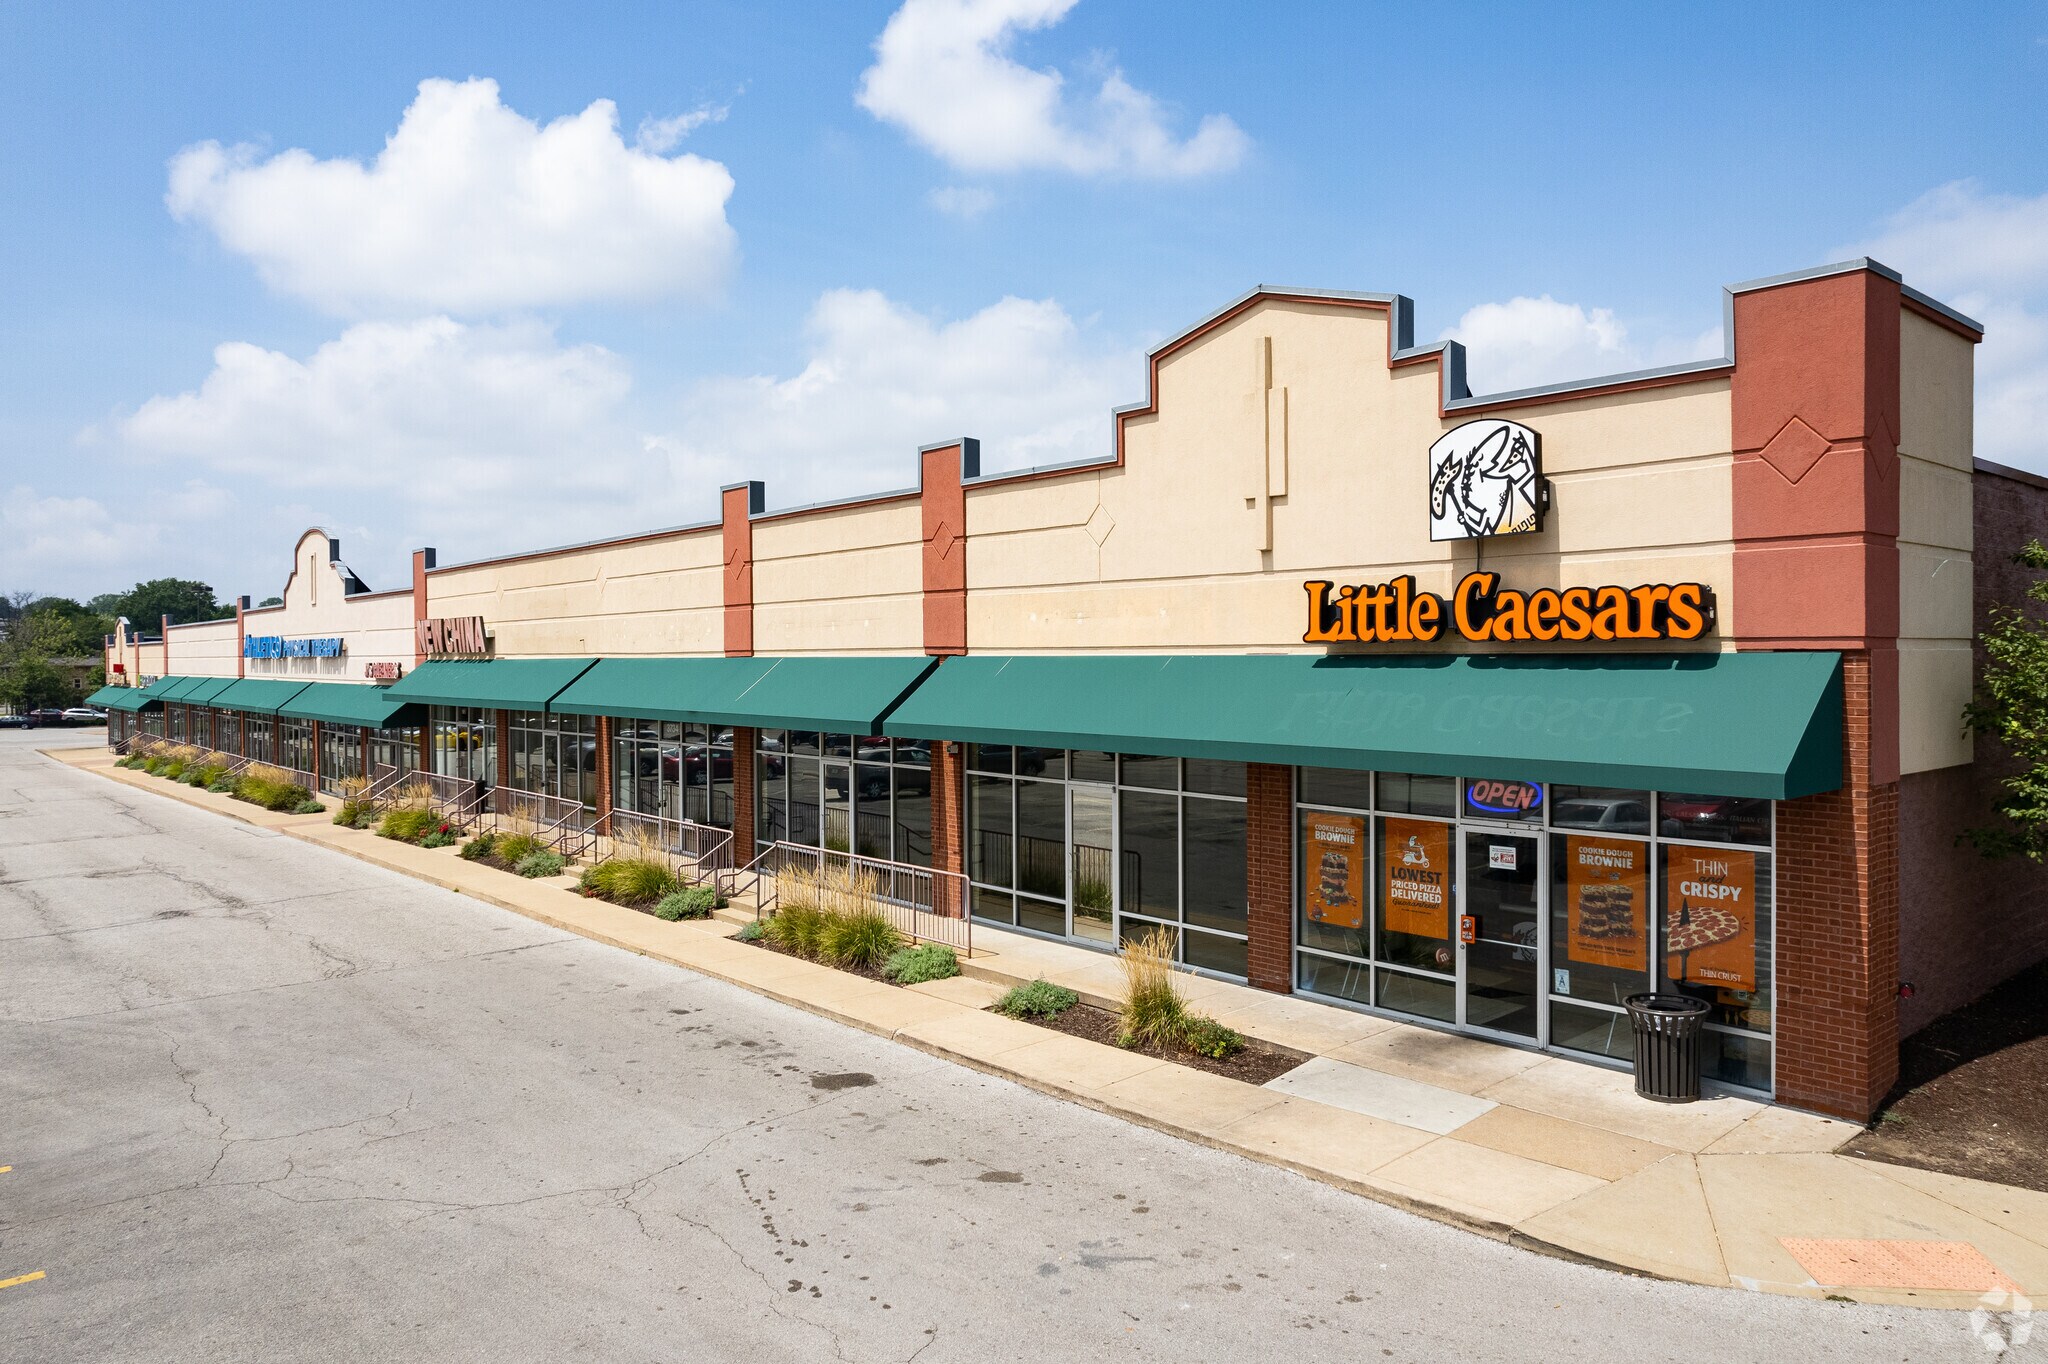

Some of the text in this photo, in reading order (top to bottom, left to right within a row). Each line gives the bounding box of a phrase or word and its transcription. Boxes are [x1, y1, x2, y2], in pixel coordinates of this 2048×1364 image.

[1303, 571, 1710, 643] Little Caesars
[444, 616, 485, 653] CHINA
[1473, 781, 1534, 810] OPEN
[1315, 824, 1355, 835] COOKIE DOUGH
[1315, 831, 1355, 845] BROWNIE
[1579, 846, 1634, 858] COOKIE DOUGH
[1579, 854, 1633, 869] BROWNIE
[1693, 858, 1728, 877] THIN
[1391, 866, 1442, 884] LOWEST
[1699, 874, 1726, 884] and
[1391, 880, 1442, 894] PRICED PIZZA
[1680, 881, 1742, 901] CRISPY
[1391, 888, 1442, 904] DELIVERED
[1699, 968, 1717, 978] THIN
[1717, 971, 1742, 983] CRUST
